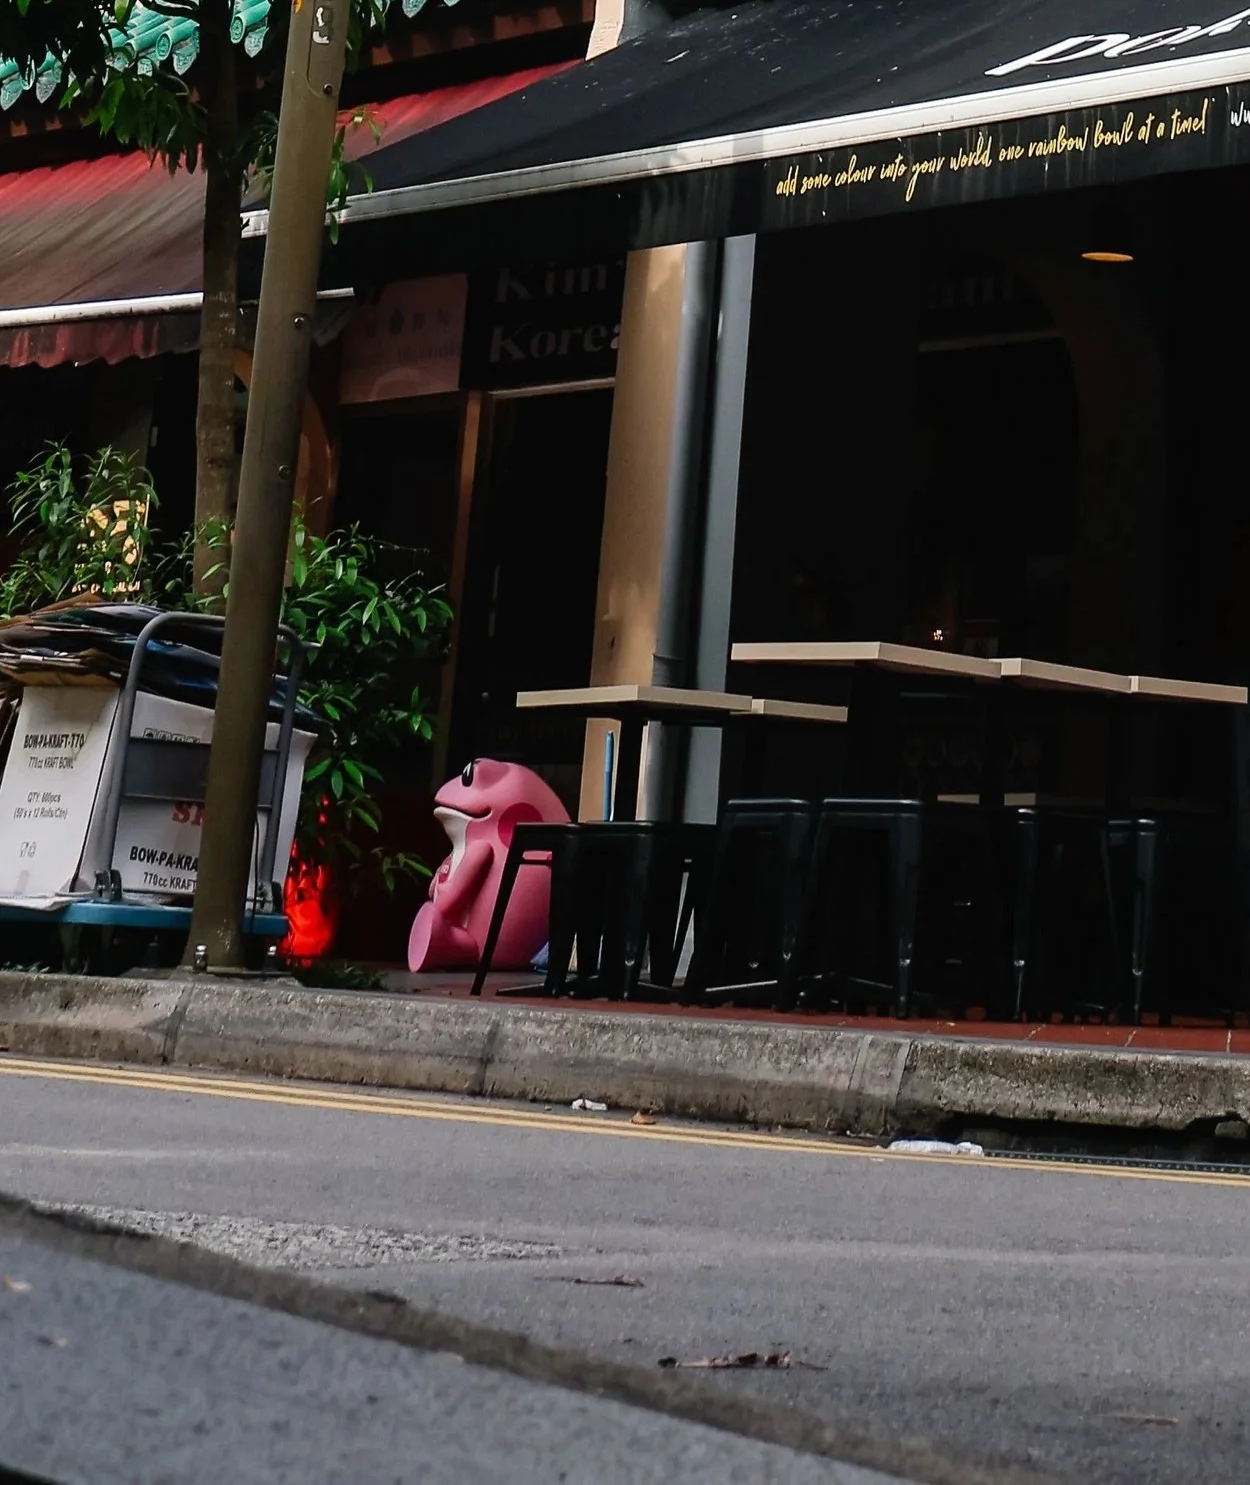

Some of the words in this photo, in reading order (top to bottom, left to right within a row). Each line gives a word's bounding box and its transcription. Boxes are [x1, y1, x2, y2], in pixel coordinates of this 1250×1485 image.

[776, 164, 800, 197] add
[800, 173, 832, 195] some
[834, 153, 877, 187] colour
[880, 155, 908, 183] into
[905, 155, 946, 203] your
[998, 143, 1024, 163] one
[1028, 124, 1089, 159] rainbow
[1093, 112, 1134, 150] bowl
[1137, 112, 1156, 145] at
[1156, 122, 1166, 140] a
[143, 871, 168, 888] 770cc
